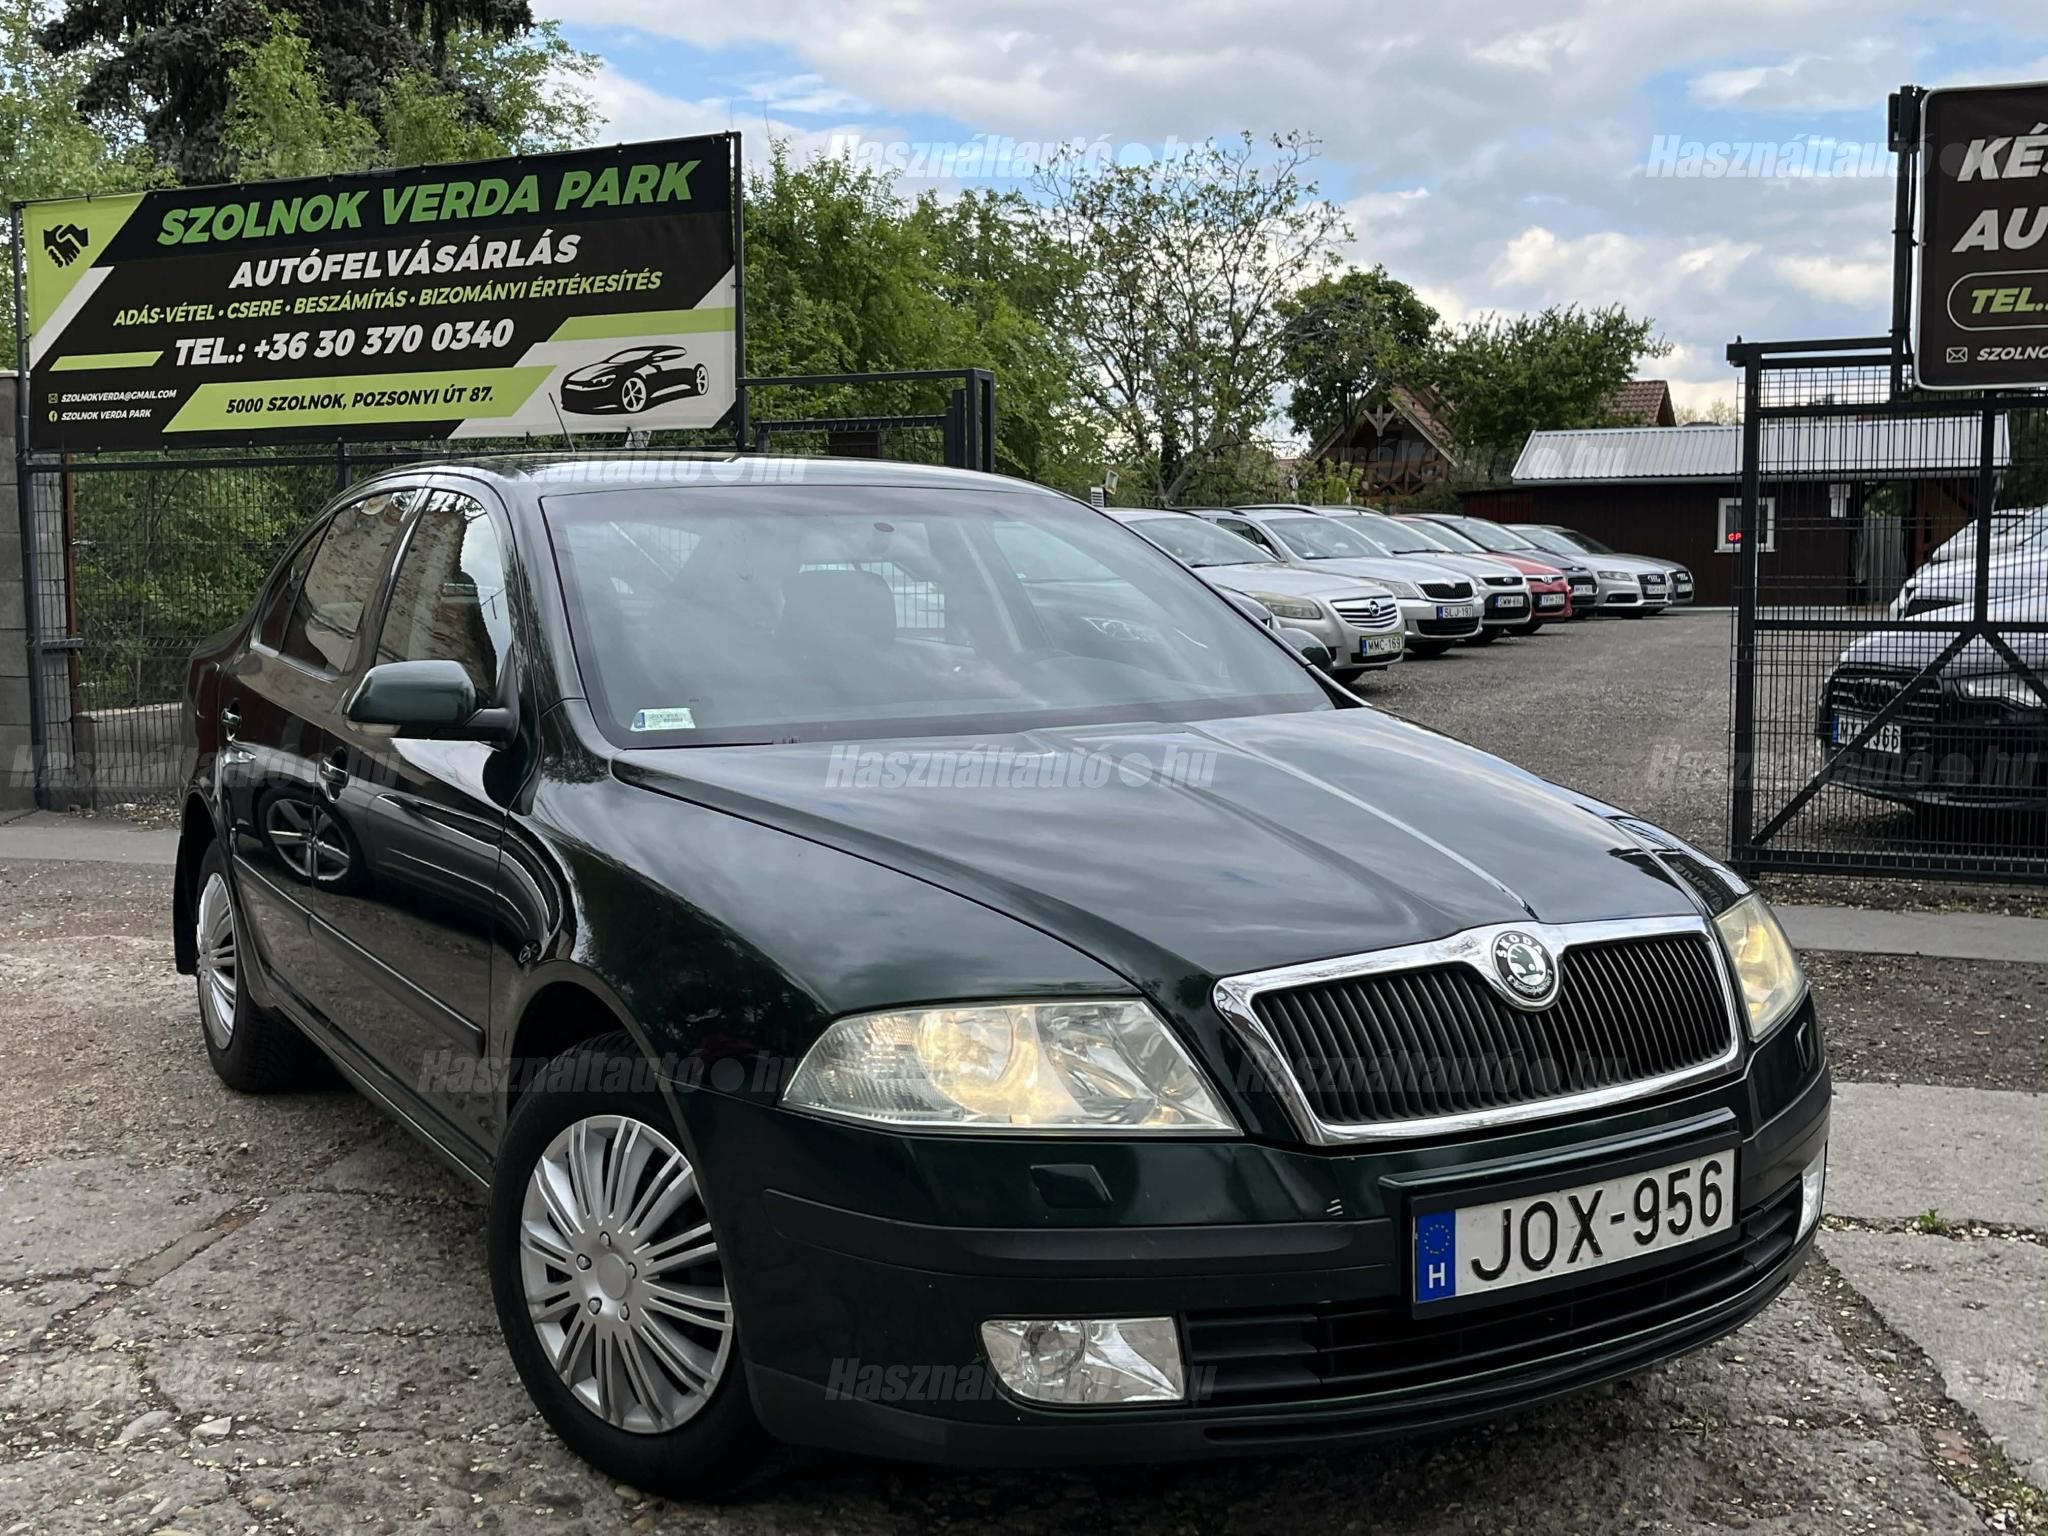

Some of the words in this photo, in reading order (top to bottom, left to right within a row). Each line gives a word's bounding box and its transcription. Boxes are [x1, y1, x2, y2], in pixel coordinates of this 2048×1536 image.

[1958, 123, 2048, 181] KÉ
[157, 191, 369, 245] SZOLNOK
[383, 175, 539, 224] VERDA
[555, 160, 700, 210] PARK
[229, 229, 581, 288] AUTÓFELVÁSÁRLÁS
[113, 302, 214, 326] ADÁS-VÉTEL
[227, 300, 283, 318] CSERE
[294, 287, 408, 314] BESZÁMÍTÁS
[419, 280, 527, 305] BIZOMÁNYI
[529, 267, 662, 297] ÉRTÉKESÍTÉS
[176, 337, 245, 366] TEL.:
[254, 332, 309, 360] +36
[314, 329, 355, 357] 30
[361, 325, 423, 355] 370
[432, 319, 514, 351] 0340
[61, 389, 177, 402] SZOLNOKVERDA@GMAIL.COM
[61, 411, 99, 420] SZOLNOK
[100, 410, 127, 419] VERDA
[128, 409, 152, 418] PARK
[226, 398, 263, 413] 5000
[267, 394, 347, 412] SZOLNOK,
[352, 389, 439, 407] POZSONYI
[443, 385, 467, 403] ÚT
[470, 387, 493, 402] 87.
[1429, 1262, 1445, 1288] H
[1471, 1160, 1722, 1281] JOX-956
